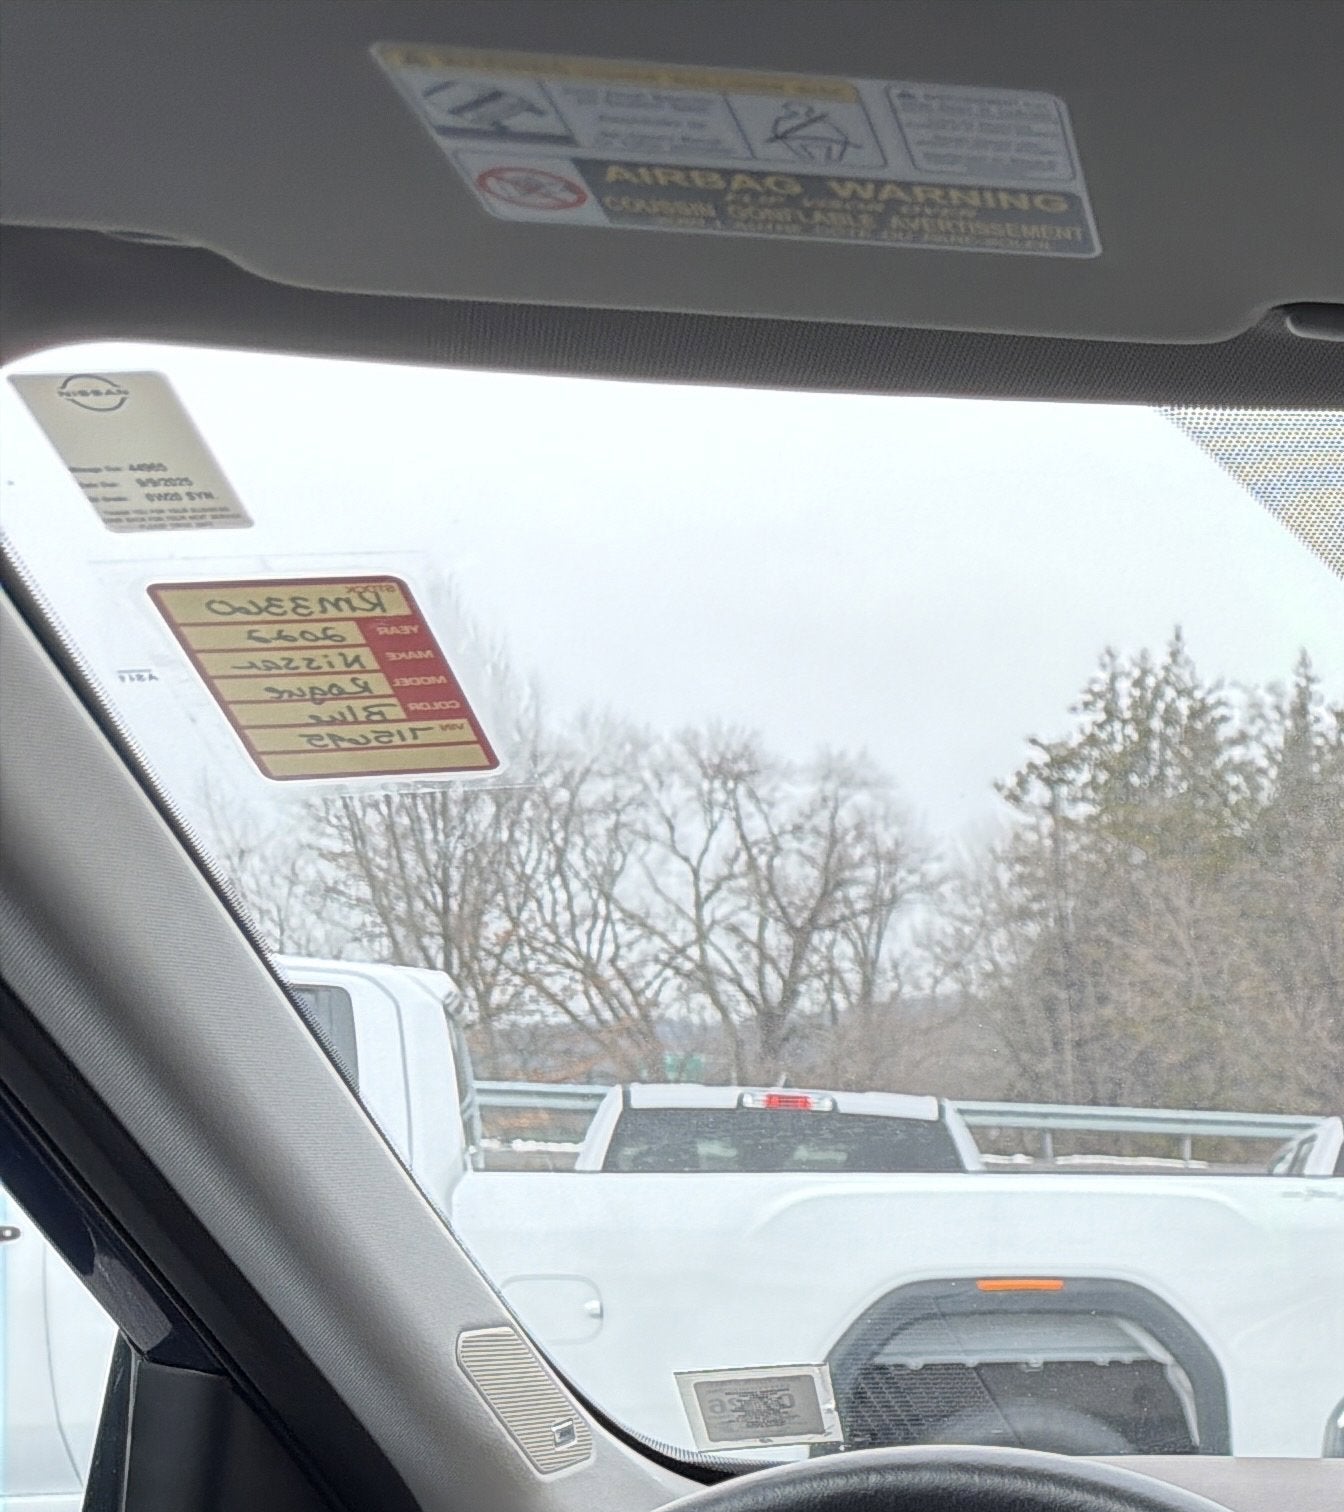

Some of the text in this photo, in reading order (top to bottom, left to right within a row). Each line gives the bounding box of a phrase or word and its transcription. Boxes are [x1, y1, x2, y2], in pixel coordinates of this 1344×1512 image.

[606, 164, 1068, 213] AIRBAG WARNING
[58, 388, 129, 398] NISSAN
